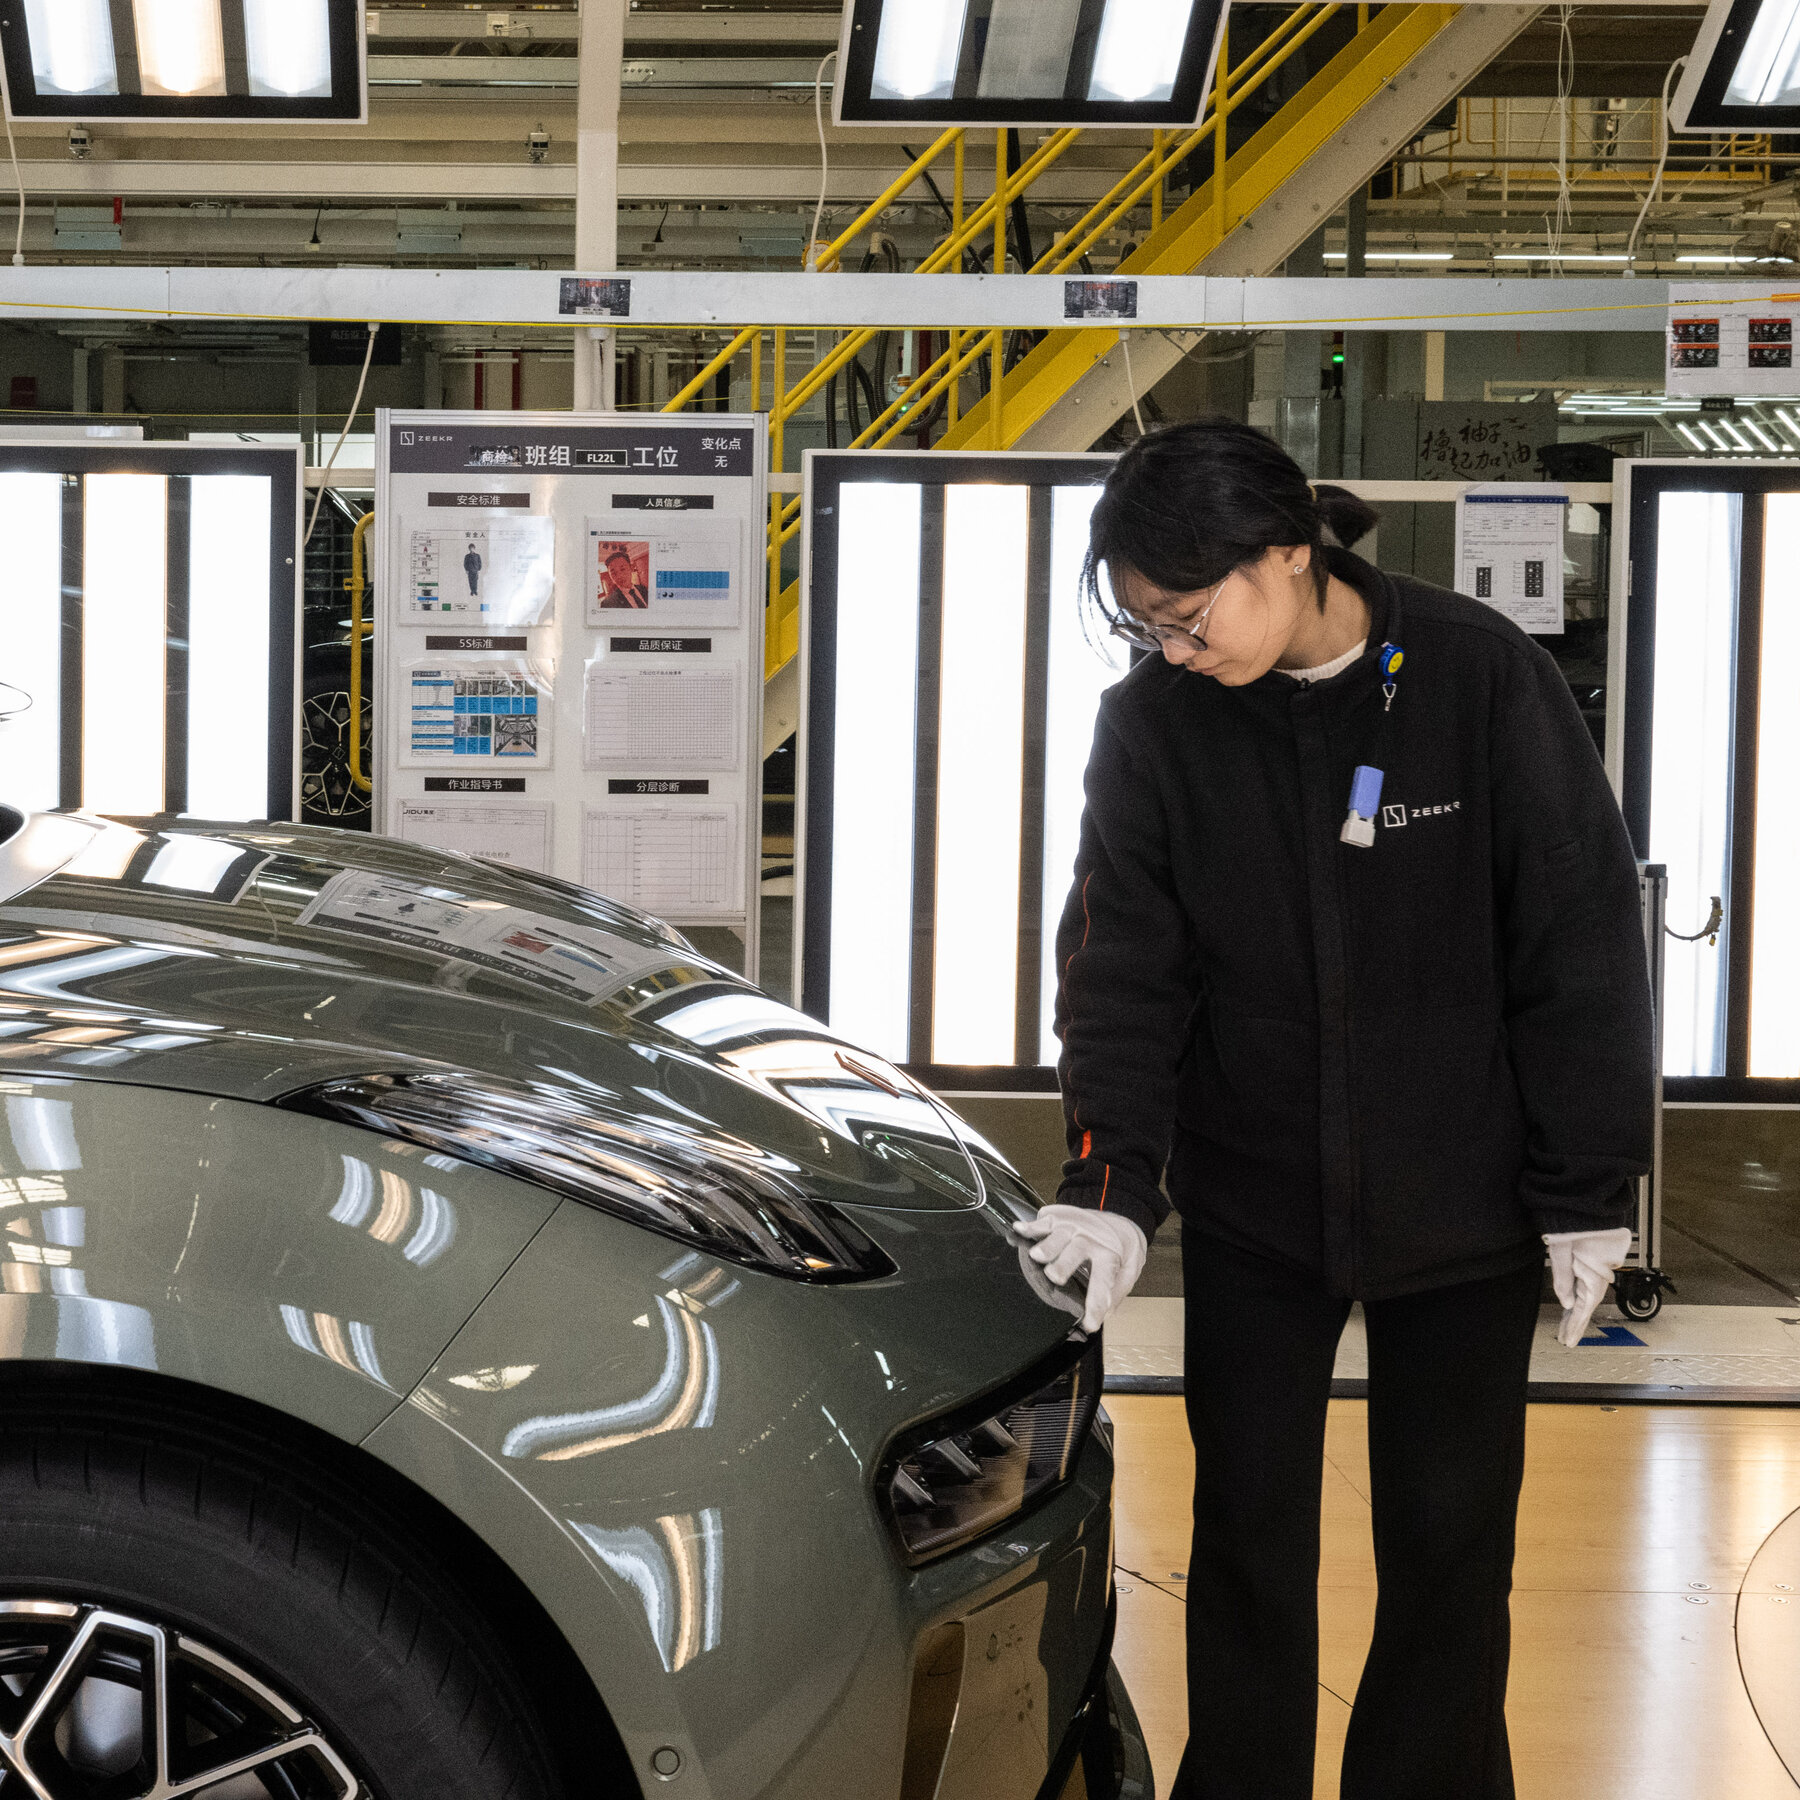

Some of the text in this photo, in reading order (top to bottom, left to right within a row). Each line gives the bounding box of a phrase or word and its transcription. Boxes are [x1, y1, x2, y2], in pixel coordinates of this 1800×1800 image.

[701, 438, 742, 450] 变化点
[525, 445, 571, 466] 班组
[587, 453, 616, 463] FL22L
[632, 446, 679, 467] 工位
[714, 455, 728, 468] 无
[456, 495, 501, 505] 安全标准
[645, 498, 683, 508] 人员信息
[459, 639, 494, 649] 5S标准
[639, 640, 683, 651] 品质保证
[448, 779, 503, 790] 作业指导书
[636, 781, 680, 792] 分层诊断
[1410, 801, 1461, 818] ZEEKR
